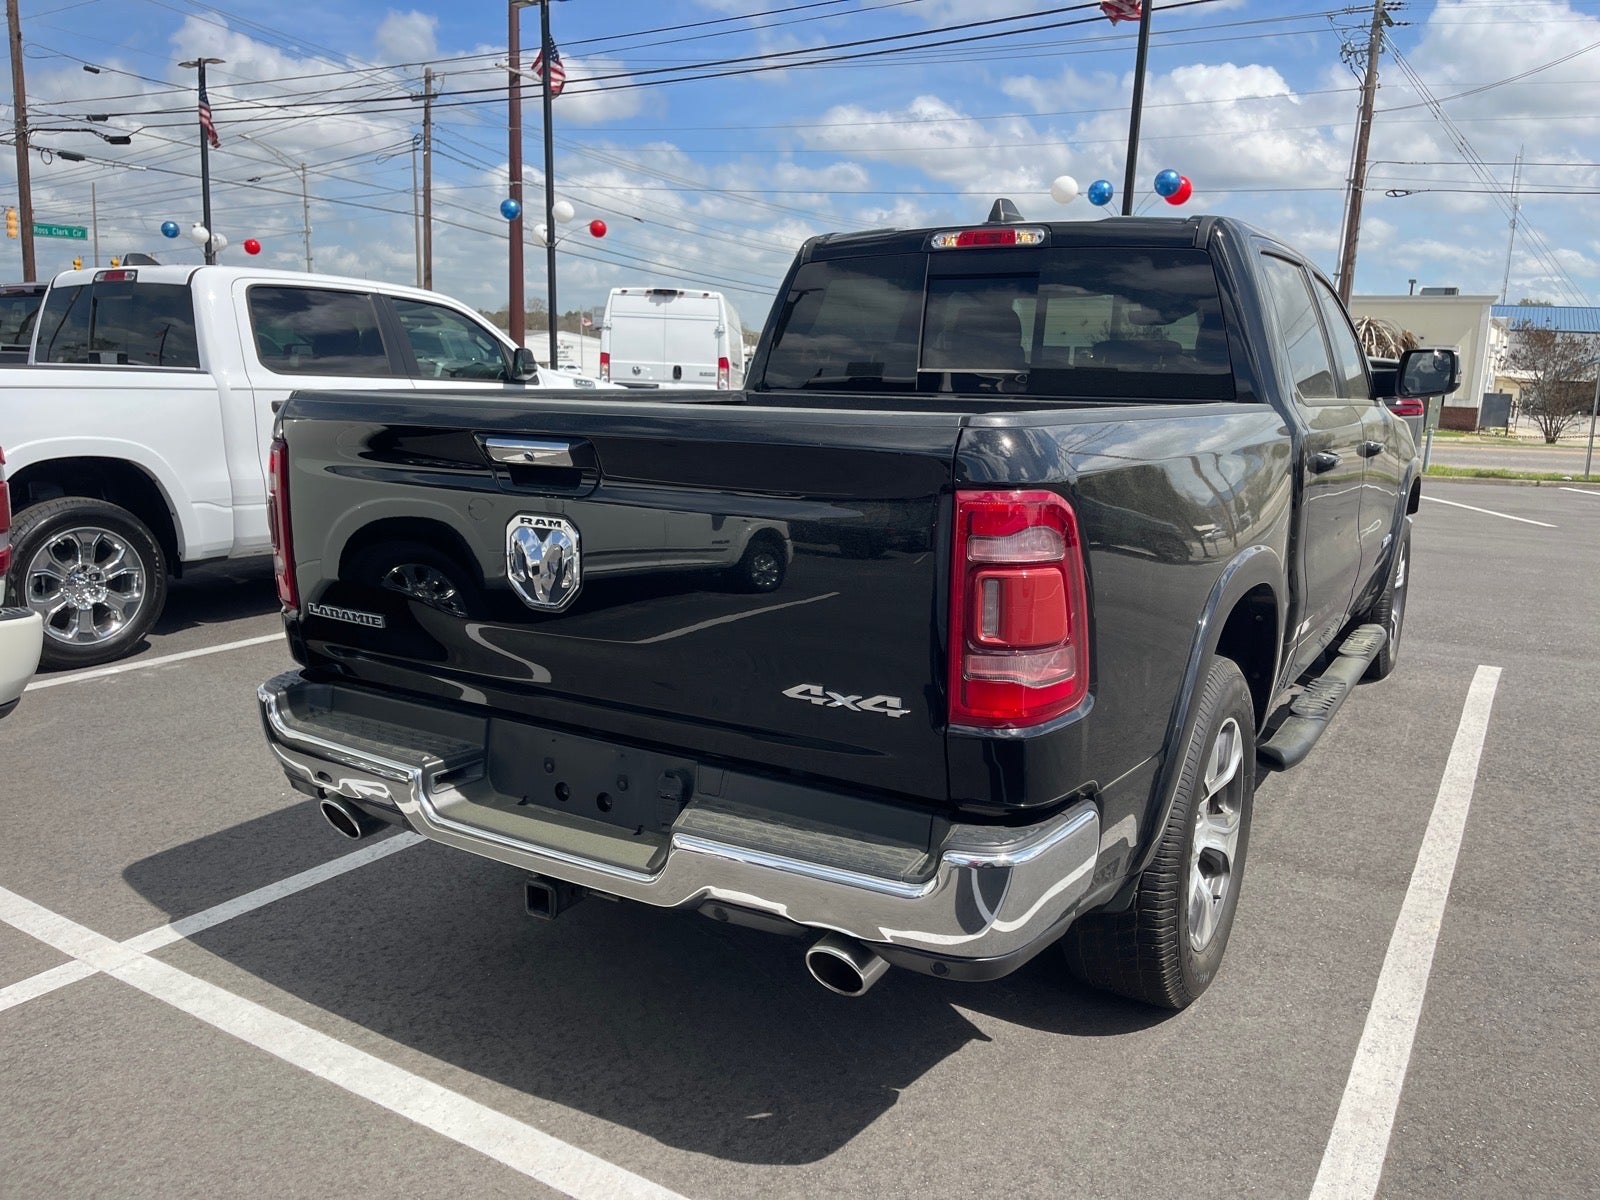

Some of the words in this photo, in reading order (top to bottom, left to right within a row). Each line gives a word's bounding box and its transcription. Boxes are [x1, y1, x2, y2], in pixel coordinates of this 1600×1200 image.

[33, 225, 49, 235] Ross
[52, 227, 69, 236] Clark
[72, 229, 83, 237] Cir
[520, 517, 562, 528] RAM
[307, 602, 385, 628] LARAMIE
[781, 683, 911, 718] 4x4
